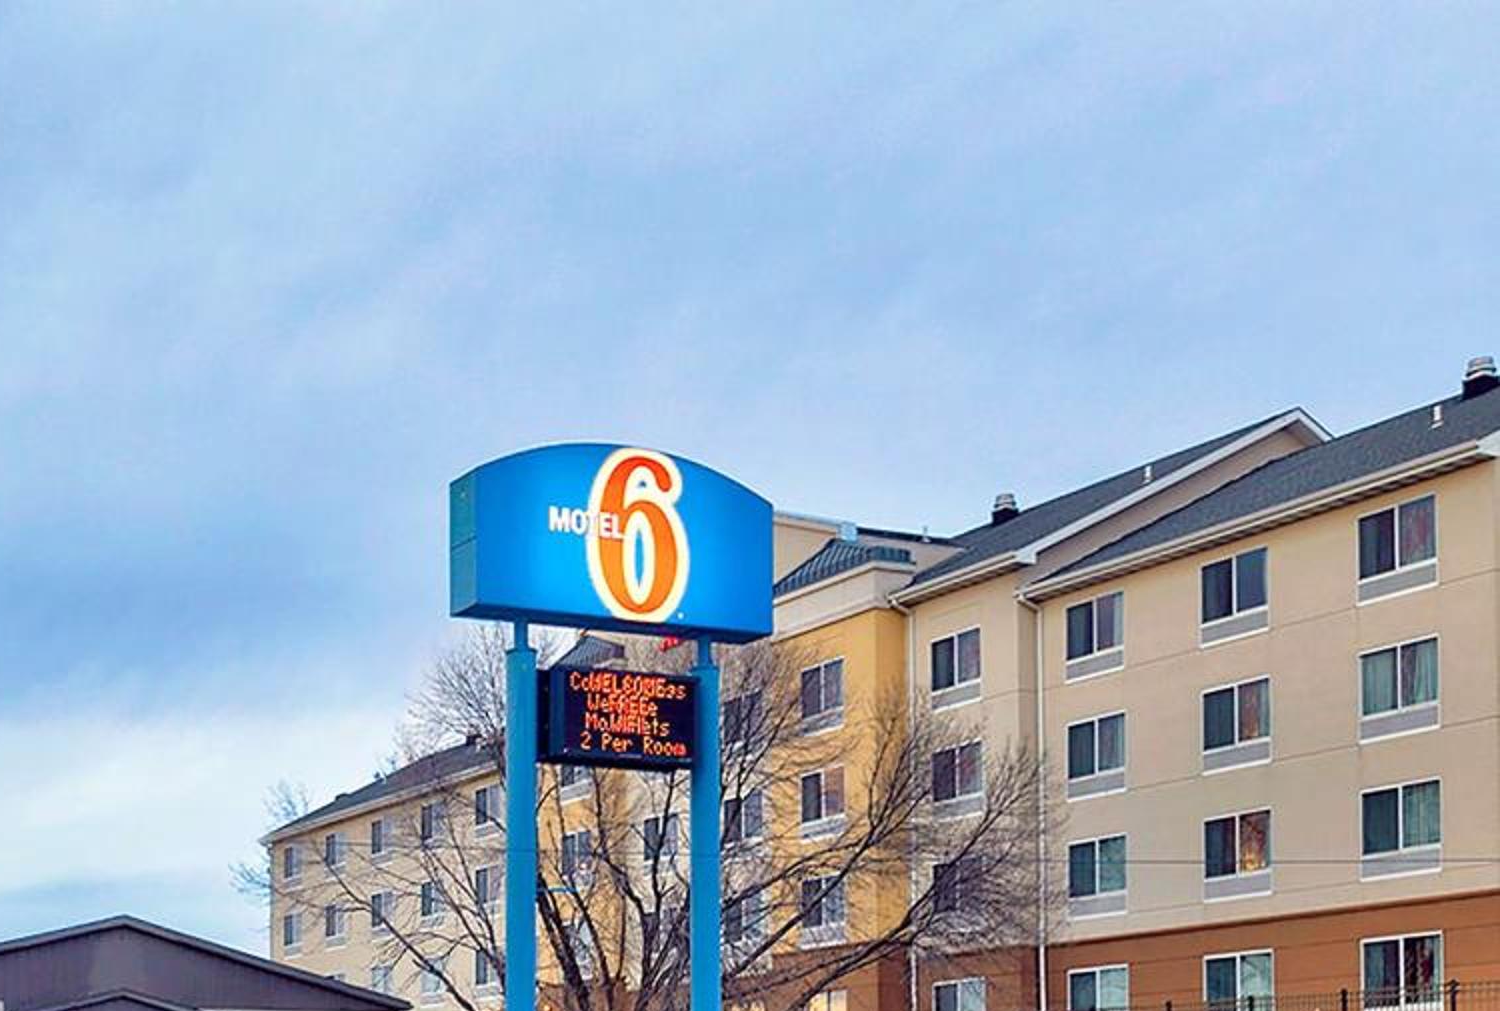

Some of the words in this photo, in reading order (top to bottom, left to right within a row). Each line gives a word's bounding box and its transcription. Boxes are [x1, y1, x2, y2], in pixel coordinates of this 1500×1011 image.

[548, 505, 624, 539] MOTEL
[587, 449, 689, 621] 6
[580, 731, 592, 751] 2
[601, 733, 634, 752] Per
[643, 735, 687, 757] Room
